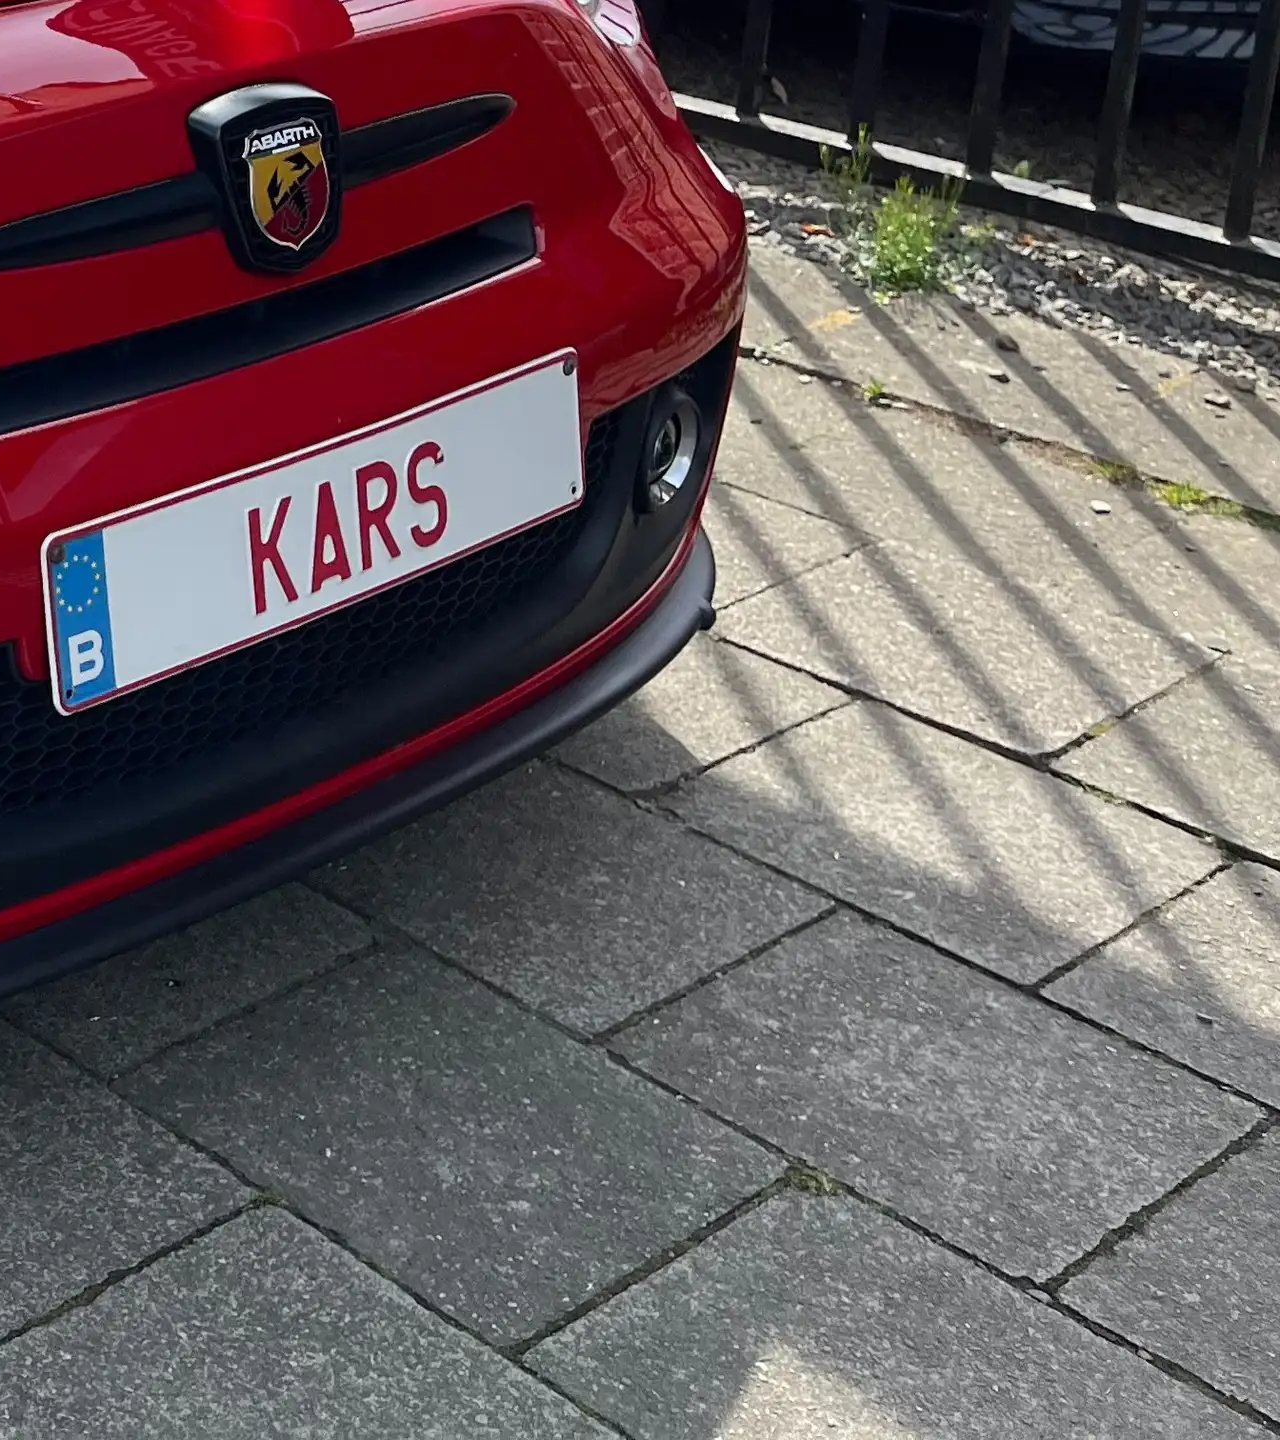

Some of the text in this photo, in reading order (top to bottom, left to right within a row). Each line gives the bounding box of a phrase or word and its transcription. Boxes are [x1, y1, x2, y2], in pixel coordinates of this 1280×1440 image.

[250, 125, 315, 153] ABARTH
[247, 441, 448, 616] KARS
[67, 629, 105, 689] B
